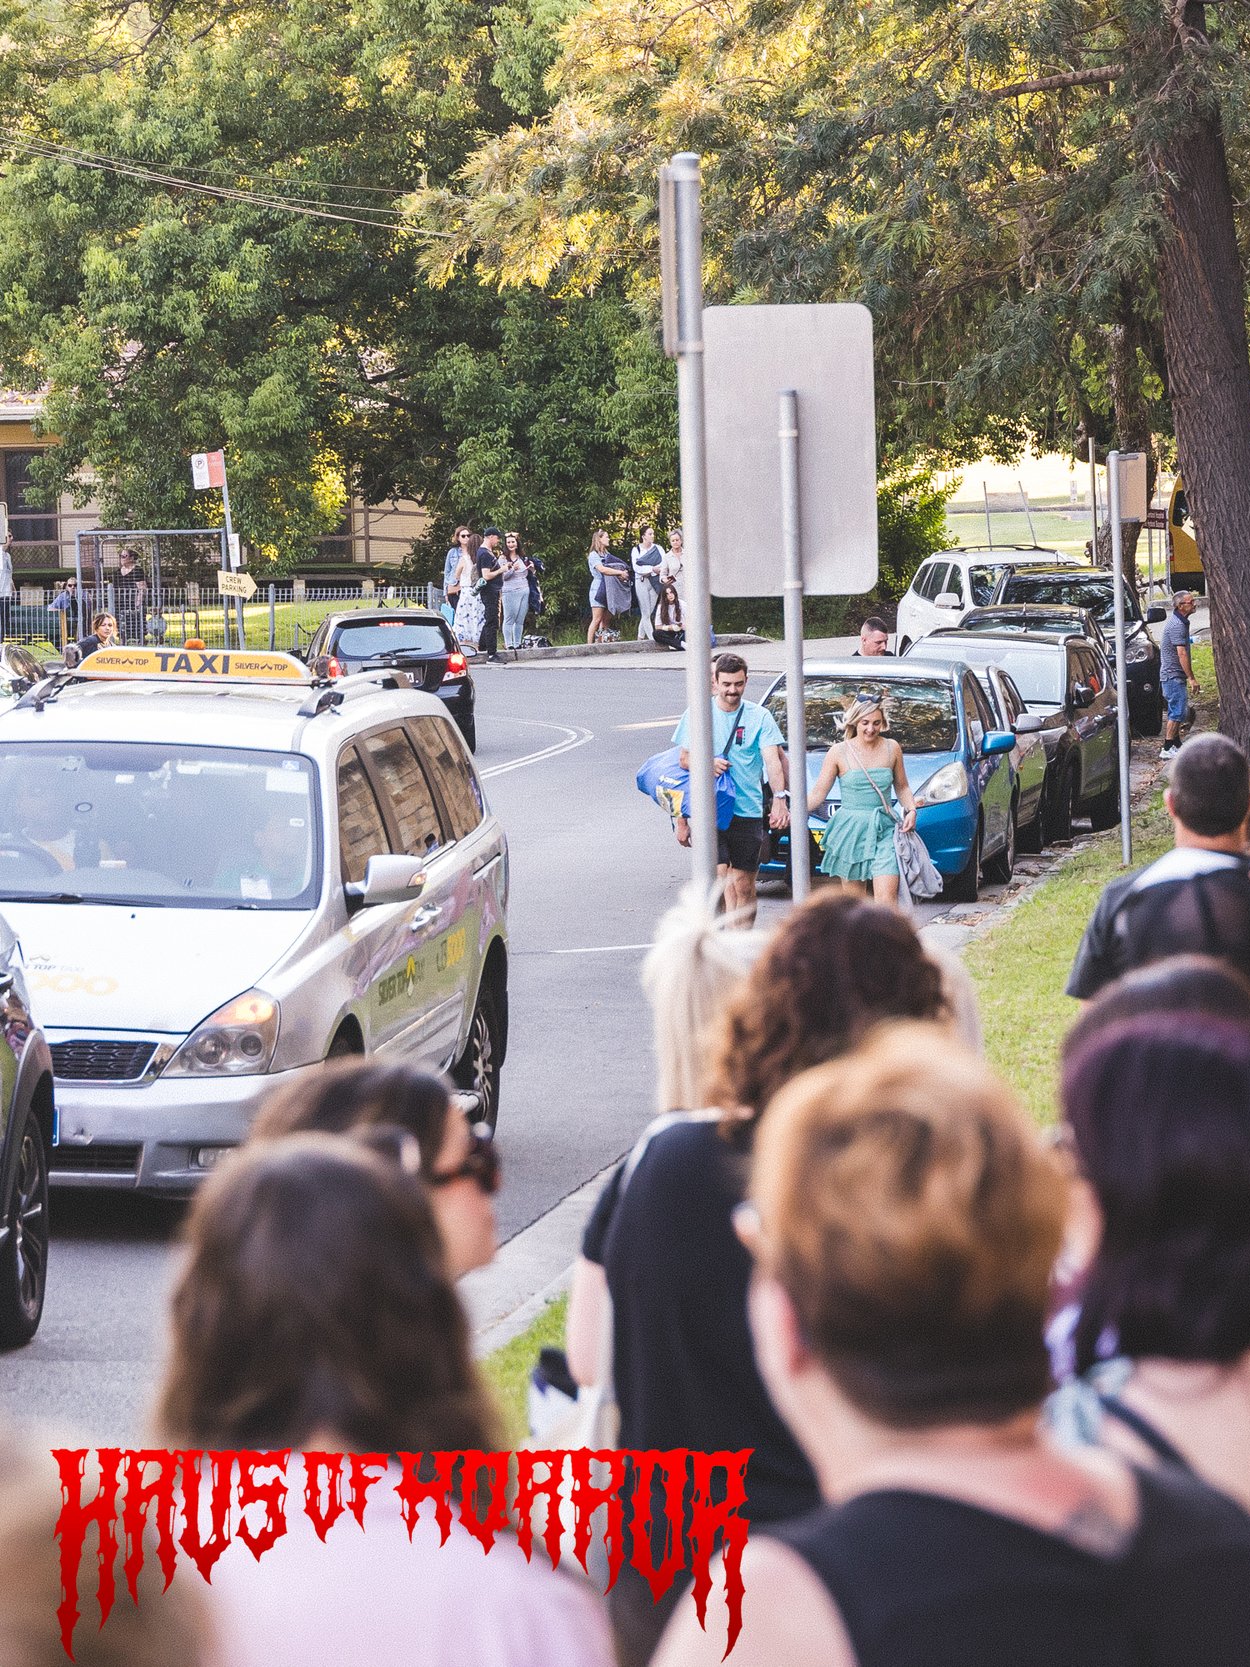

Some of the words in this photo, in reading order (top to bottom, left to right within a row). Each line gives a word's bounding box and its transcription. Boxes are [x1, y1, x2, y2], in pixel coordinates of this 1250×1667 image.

[225, 575, 242, 585] CREW
[221, 583, 247, 594] PARKING
[96, 656, 121, 665] SILVER
[134, 658, 149, 666] TOP
[154, 652, 230, 675] TAXI
[234, 662, 260, 671] SILVER
[273, 663, 288, 672] TOP
